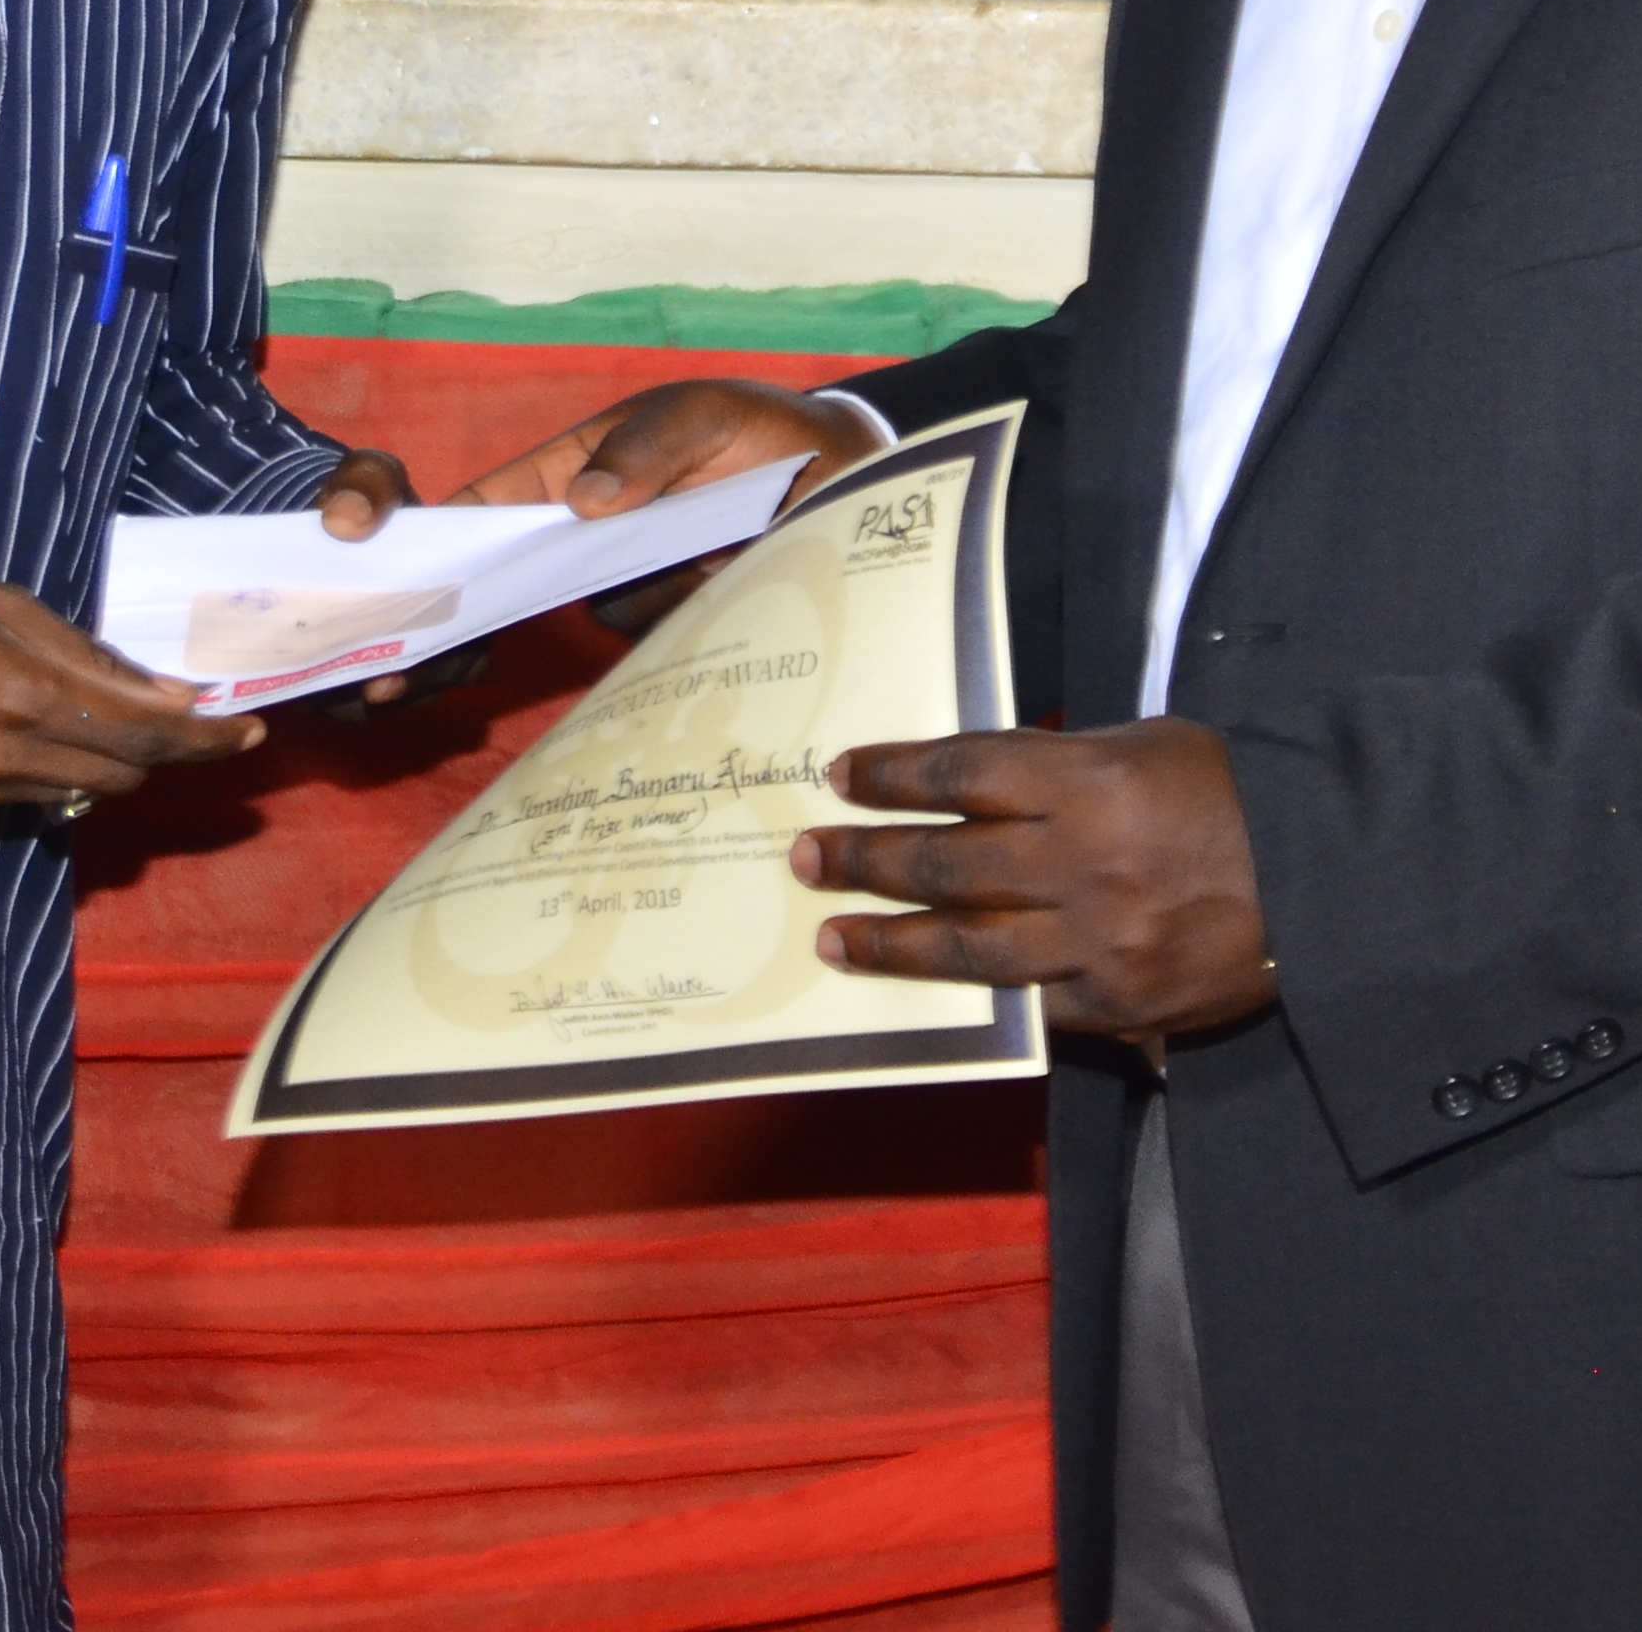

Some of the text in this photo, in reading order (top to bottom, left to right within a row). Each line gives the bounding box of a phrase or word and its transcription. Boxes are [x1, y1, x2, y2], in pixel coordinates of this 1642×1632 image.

[360, 643, 398, 665] PLC
[675, 668, 713, 700] OF
[714, 650, 819, 692] AWARD
[700, 834, 711, 845] as
[723, 830, 777, 844] Response
[778, 828, 791, 840] to
[657, 851, 730, 868] Development
[733, 850, 750, 862] for
[539, 887, 682, 919] 13th April, 2019
